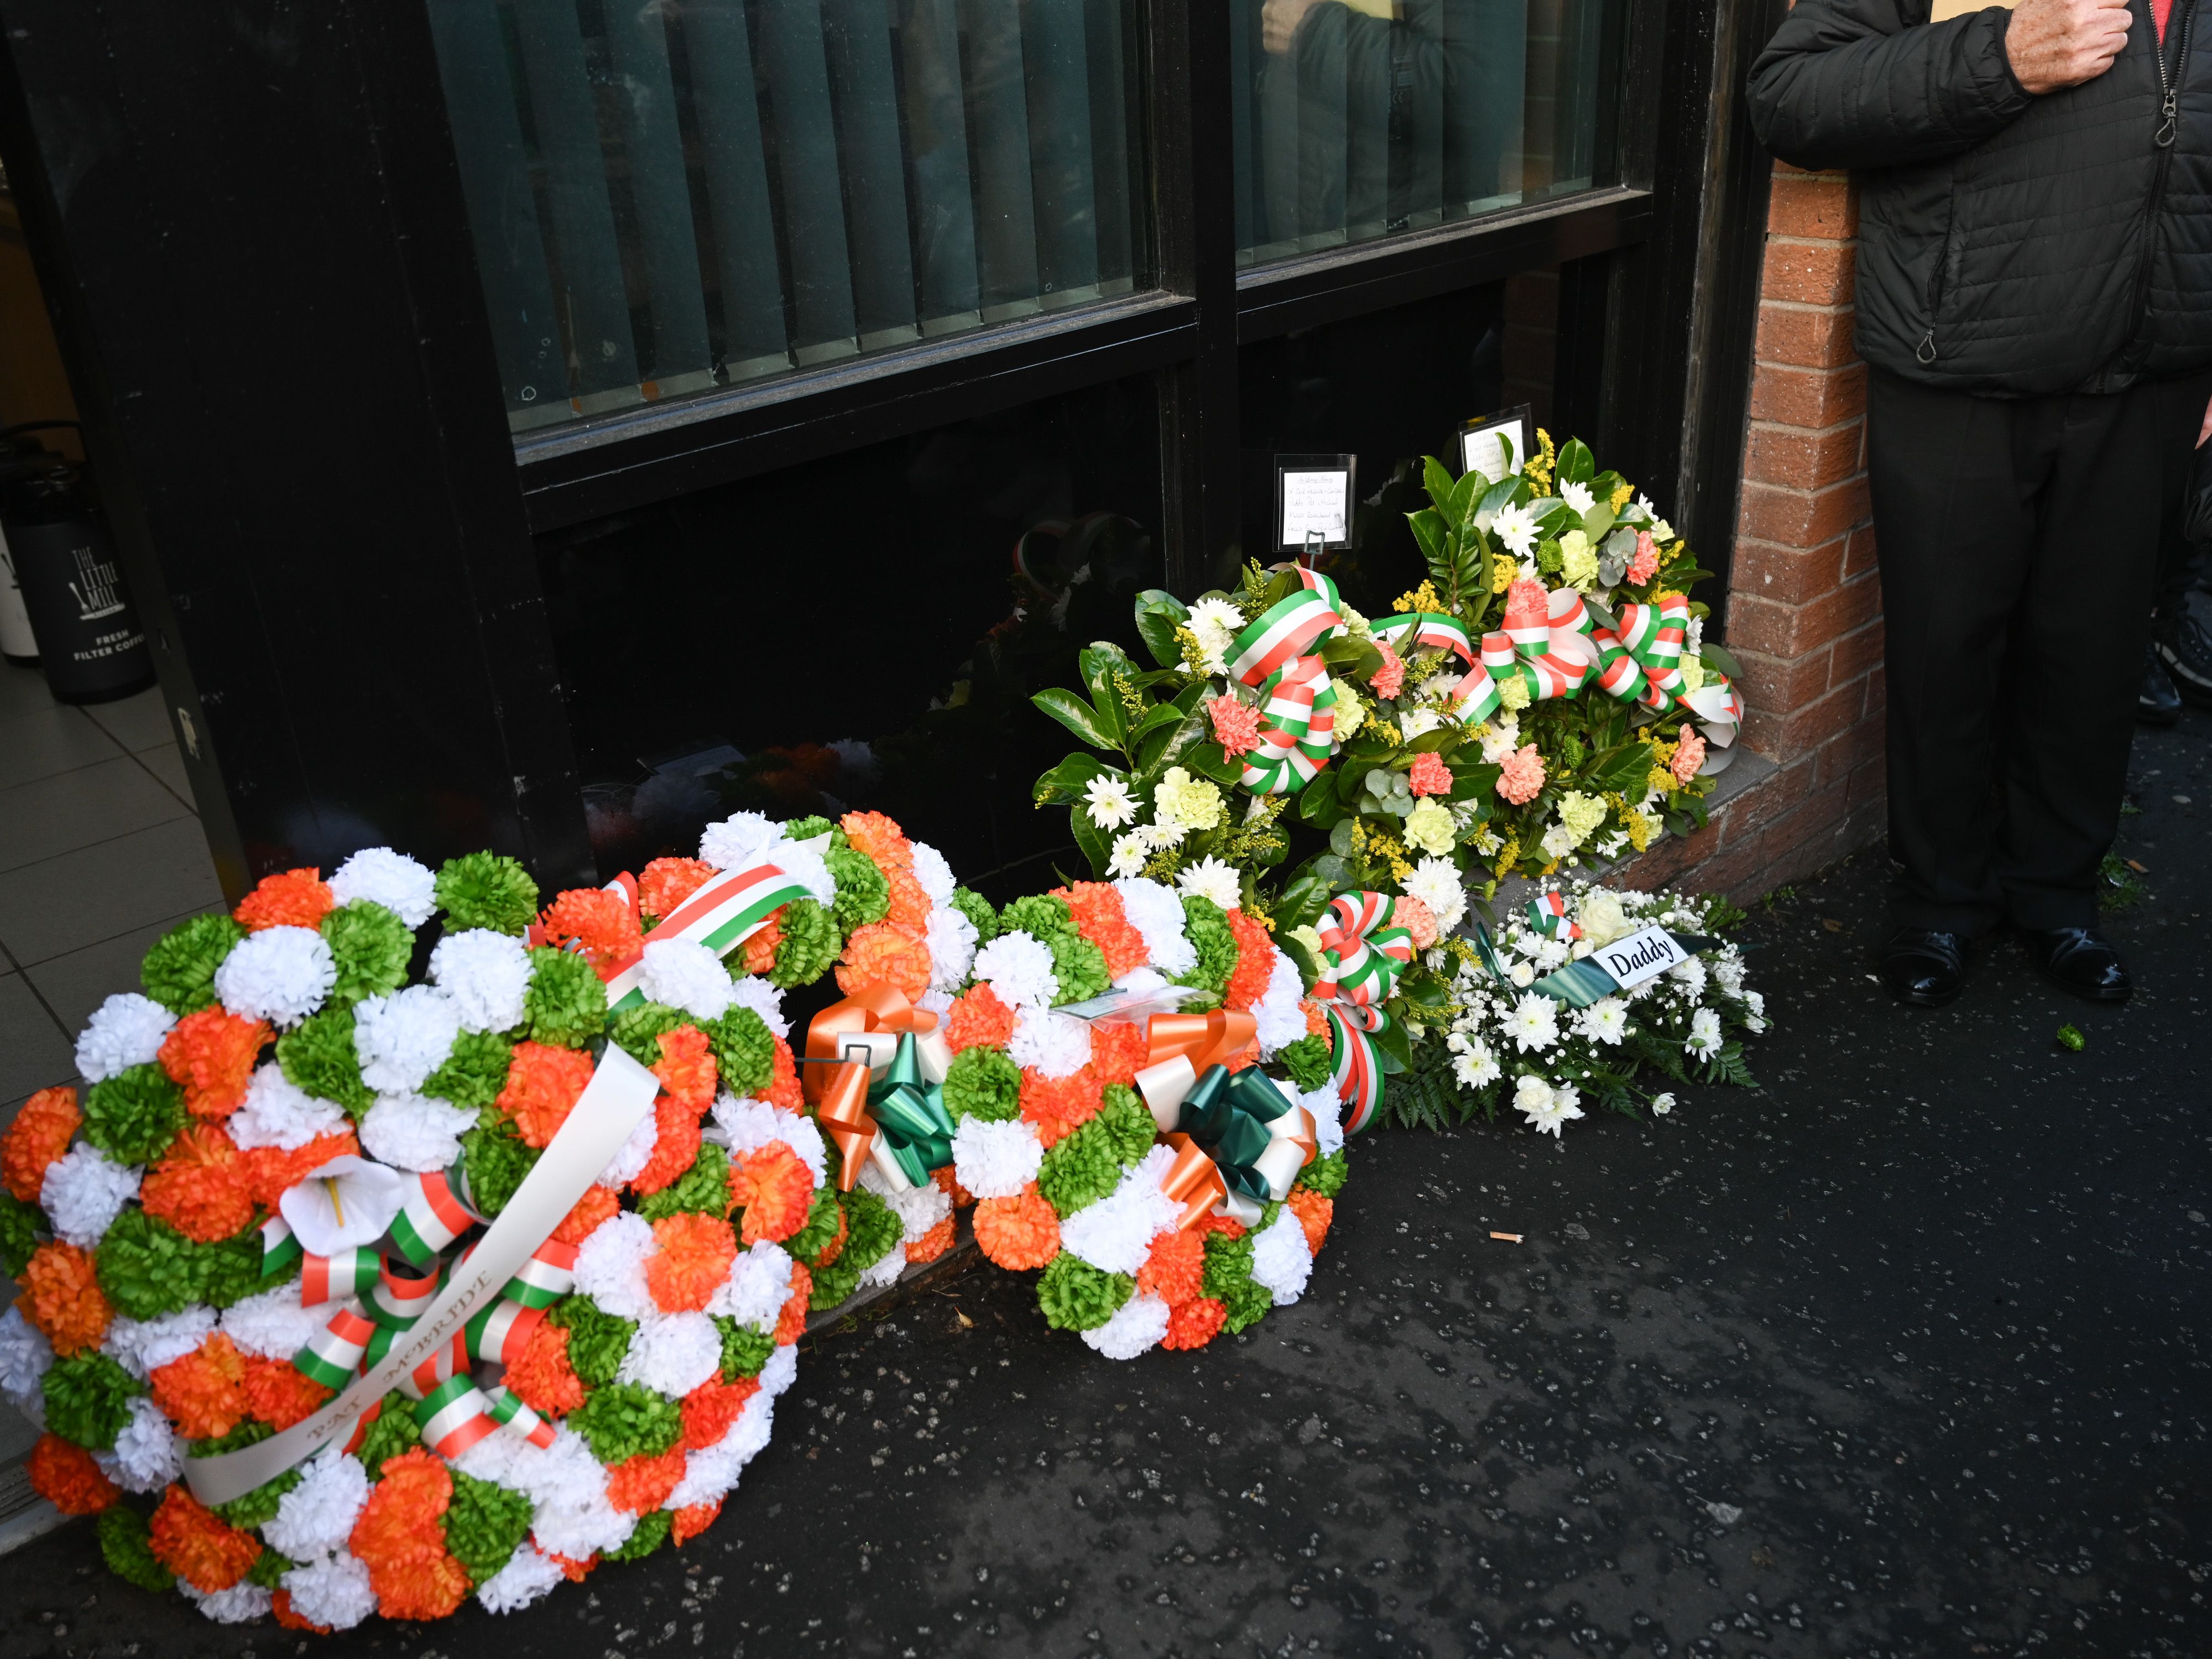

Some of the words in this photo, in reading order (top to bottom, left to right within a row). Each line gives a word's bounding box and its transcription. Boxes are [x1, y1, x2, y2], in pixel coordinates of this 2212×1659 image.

[96, 628, 129, 646] FRESH
[74, 646, 113, 661] FILTER
[1607, 936, 1674, 978] Daddy
[306, 1395, 362, 1439] PAT
